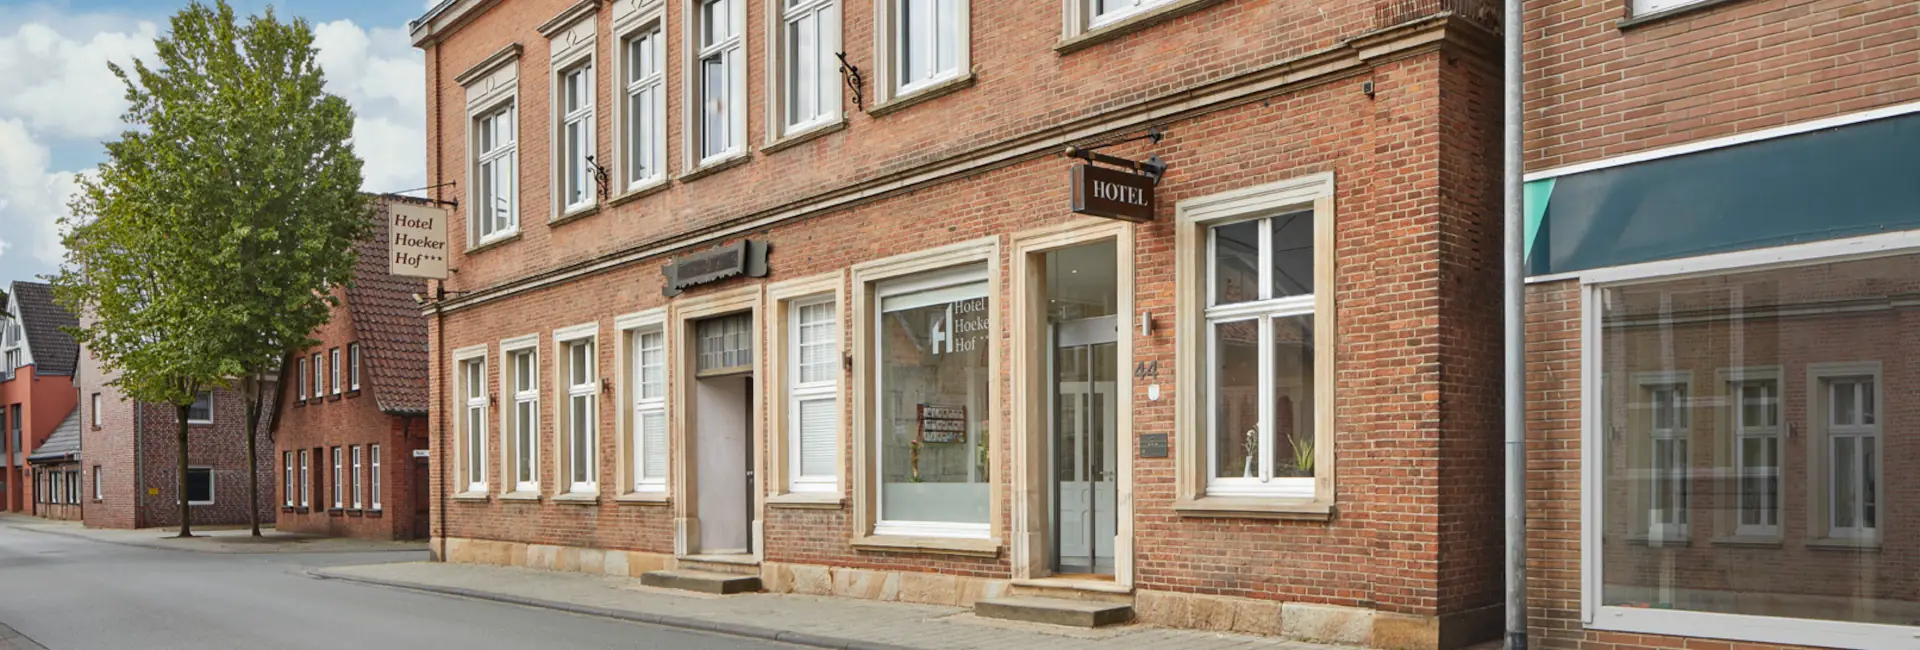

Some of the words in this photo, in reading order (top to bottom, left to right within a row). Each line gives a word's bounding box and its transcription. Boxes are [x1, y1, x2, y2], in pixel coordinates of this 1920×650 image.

[1093, 180, 1149, 207] HOTEL
[394, 213, 434, 230] Hotel
[394, 232, 446, 250] Hoeker
[394, 251, 424, 269] Hof
[954, 297, 985, 314] Hotel
[954, 315, 991, 333] Hoeke
[954, 336, 977, 352] Hof
[1135, 360, 1158, 380] 44
